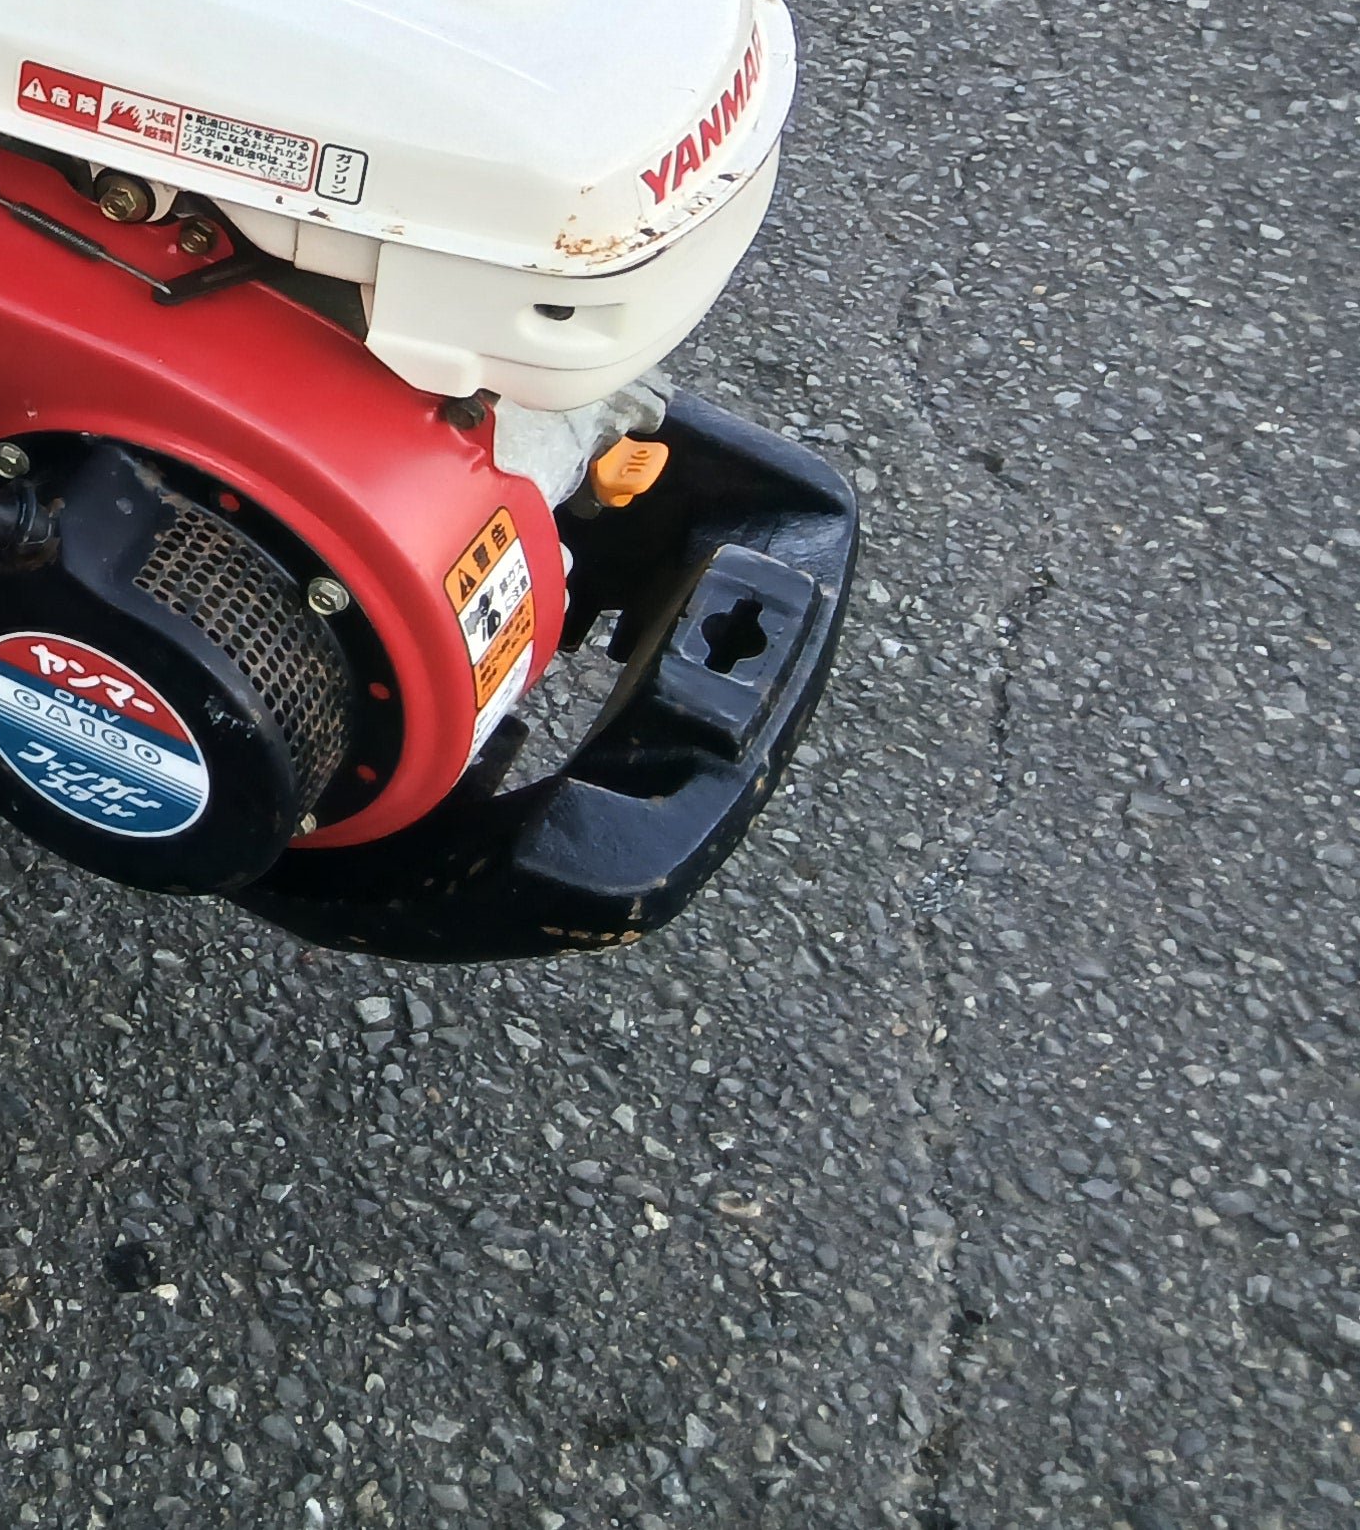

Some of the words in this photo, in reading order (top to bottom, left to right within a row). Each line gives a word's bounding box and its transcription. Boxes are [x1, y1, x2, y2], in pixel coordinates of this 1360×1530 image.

[50, 86, 98, 117] 危険
[146, 108, 177, 128] 火気
[639, 19, 763, 206] YANMAR
[330, 153, 353, 195] ガソリン
[30, 644, 156, 713] ヤンマー
[54, 688, 121, 722] OHV
[17, 740, 163, 810] フィンガー
[38, 773, 137, 818] スタート
